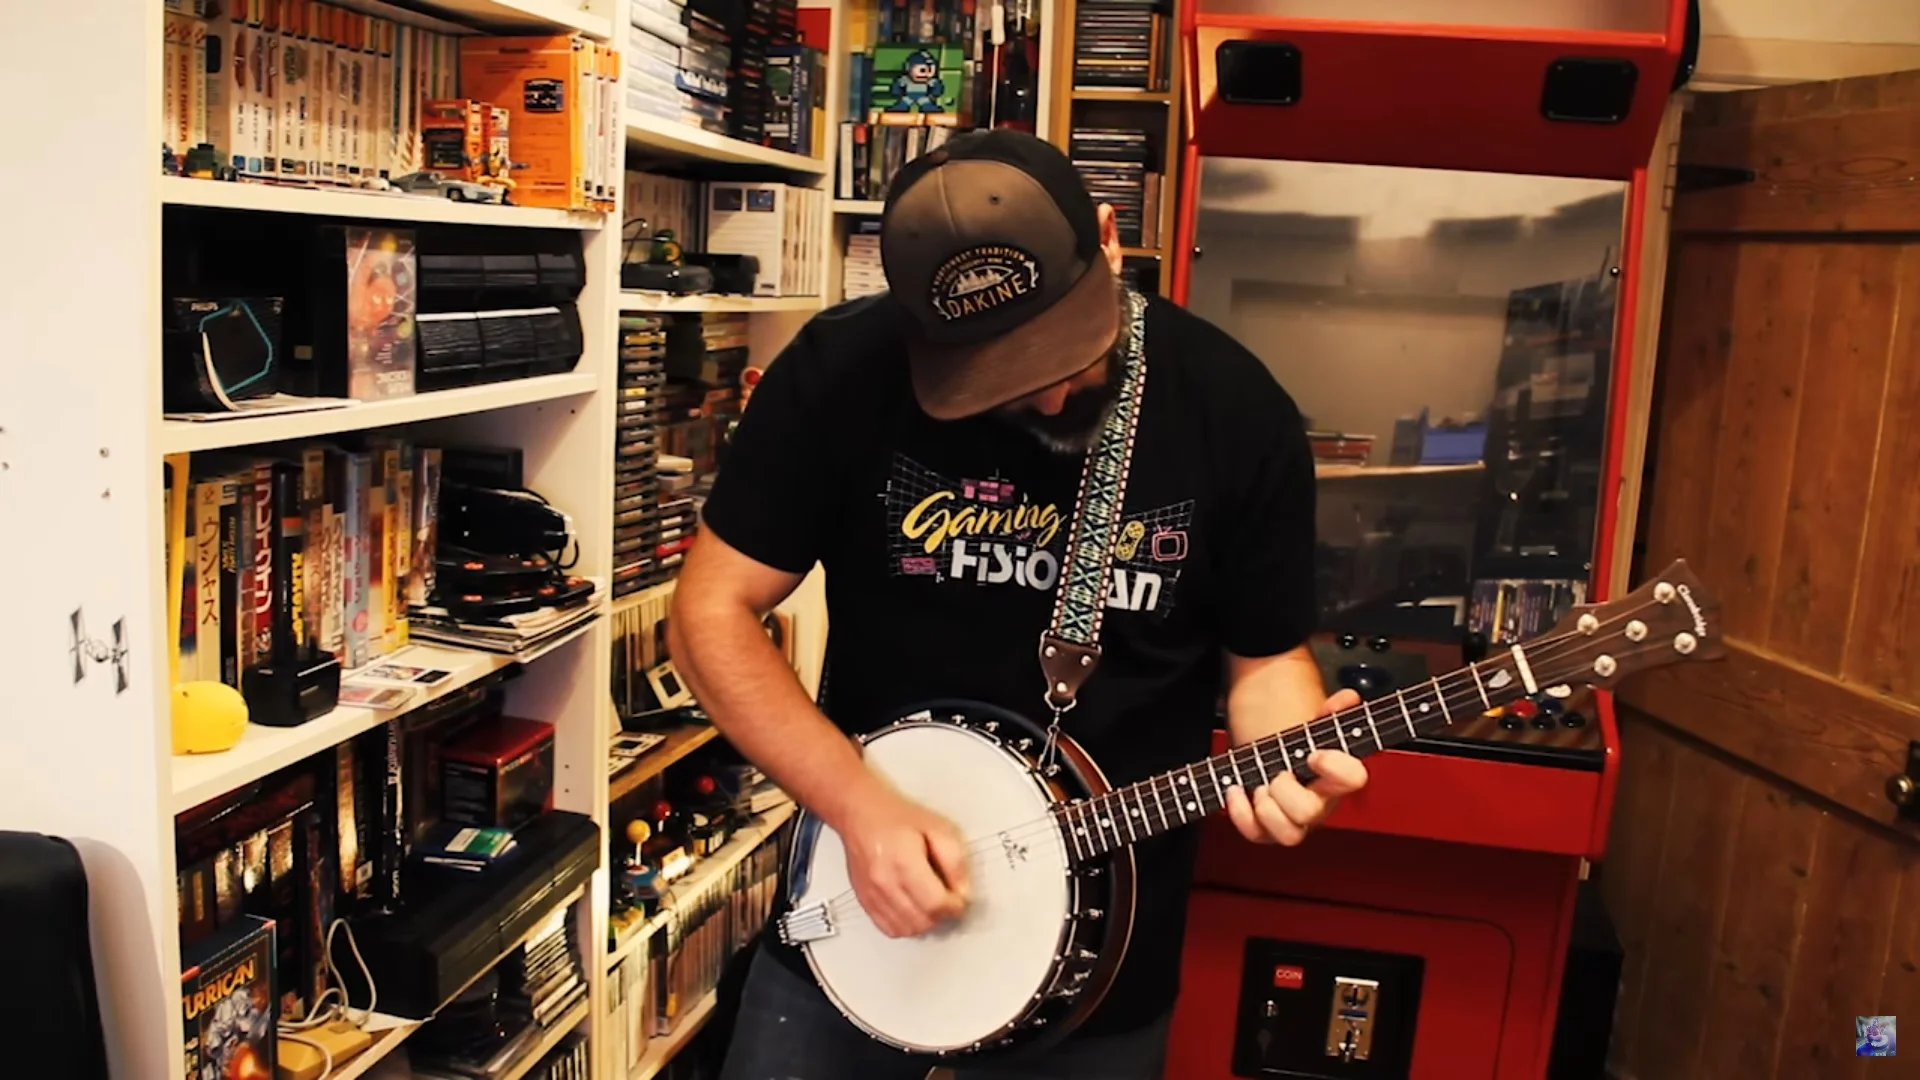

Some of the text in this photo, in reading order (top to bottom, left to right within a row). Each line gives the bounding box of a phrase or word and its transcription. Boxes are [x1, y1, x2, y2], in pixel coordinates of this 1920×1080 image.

[946, 273, 1027, 318] DAKINE
[901, 490, 1068, 554] Gaming
[1275, 968, 1303, 981] COIN
